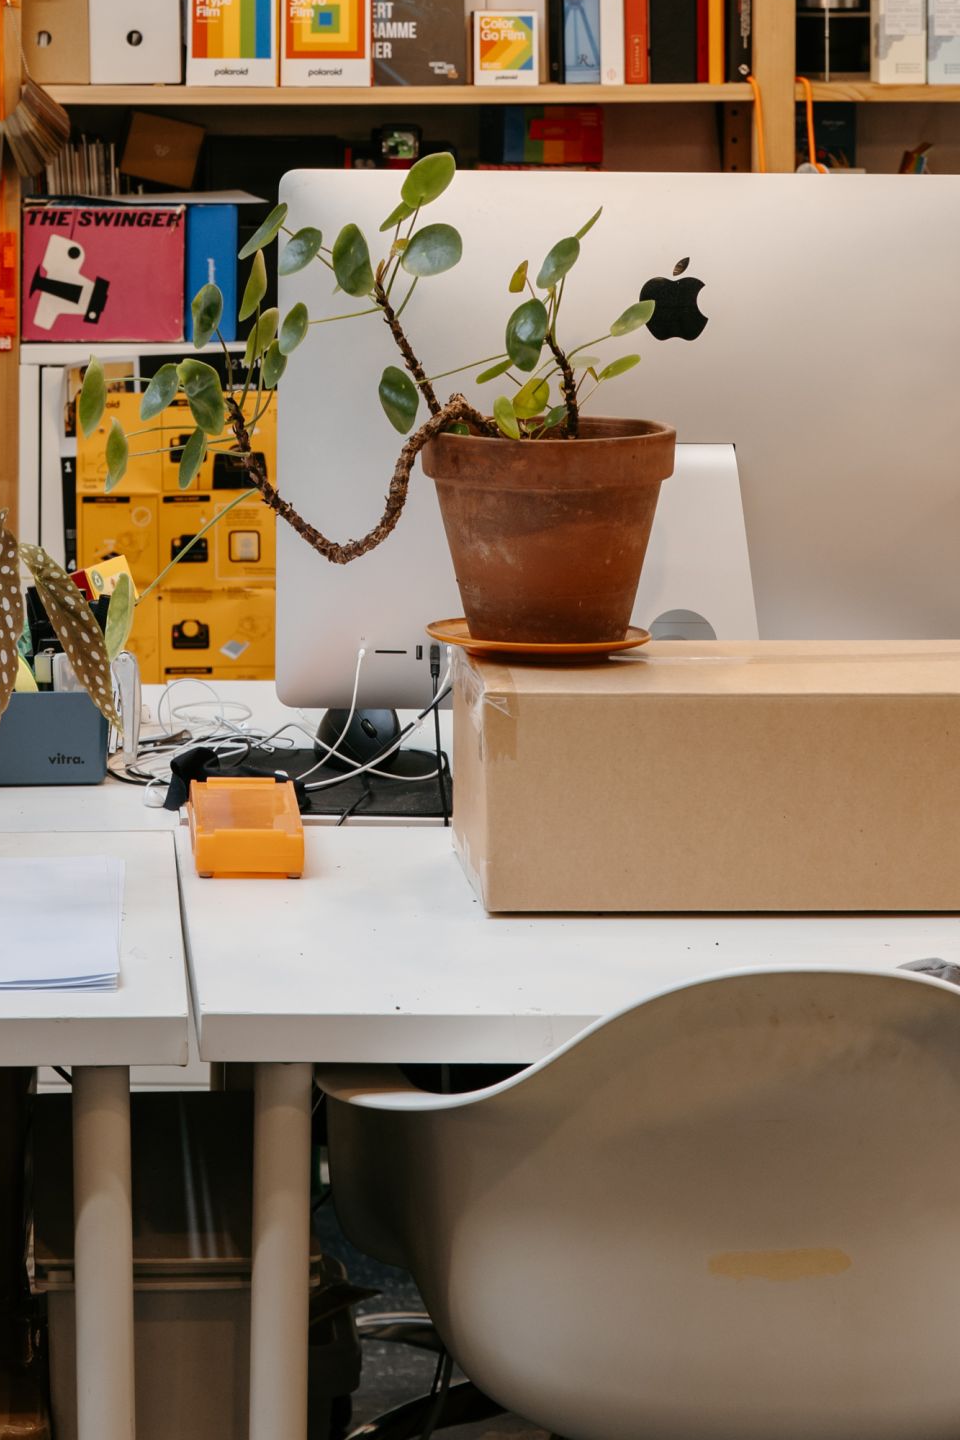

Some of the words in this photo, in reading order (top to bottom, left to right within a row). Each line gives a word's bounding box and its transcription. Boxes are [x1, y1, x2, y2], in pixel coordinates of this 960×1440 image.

[196, 6, 220, 17] Film
[290, 6, 315, 17] Film
[481, 18, 515, 29] Color
[481, 30, 499, 41] Go
[500, 30, 526, 41] Film
[214, 68, 248, 77] polaroid
[308, 68, 342, 77] polaroid
[27, 211, 72, 227] THE
[78, 211, 182, 228] SWINGER
[48, 753, 85, 764] vitra.
